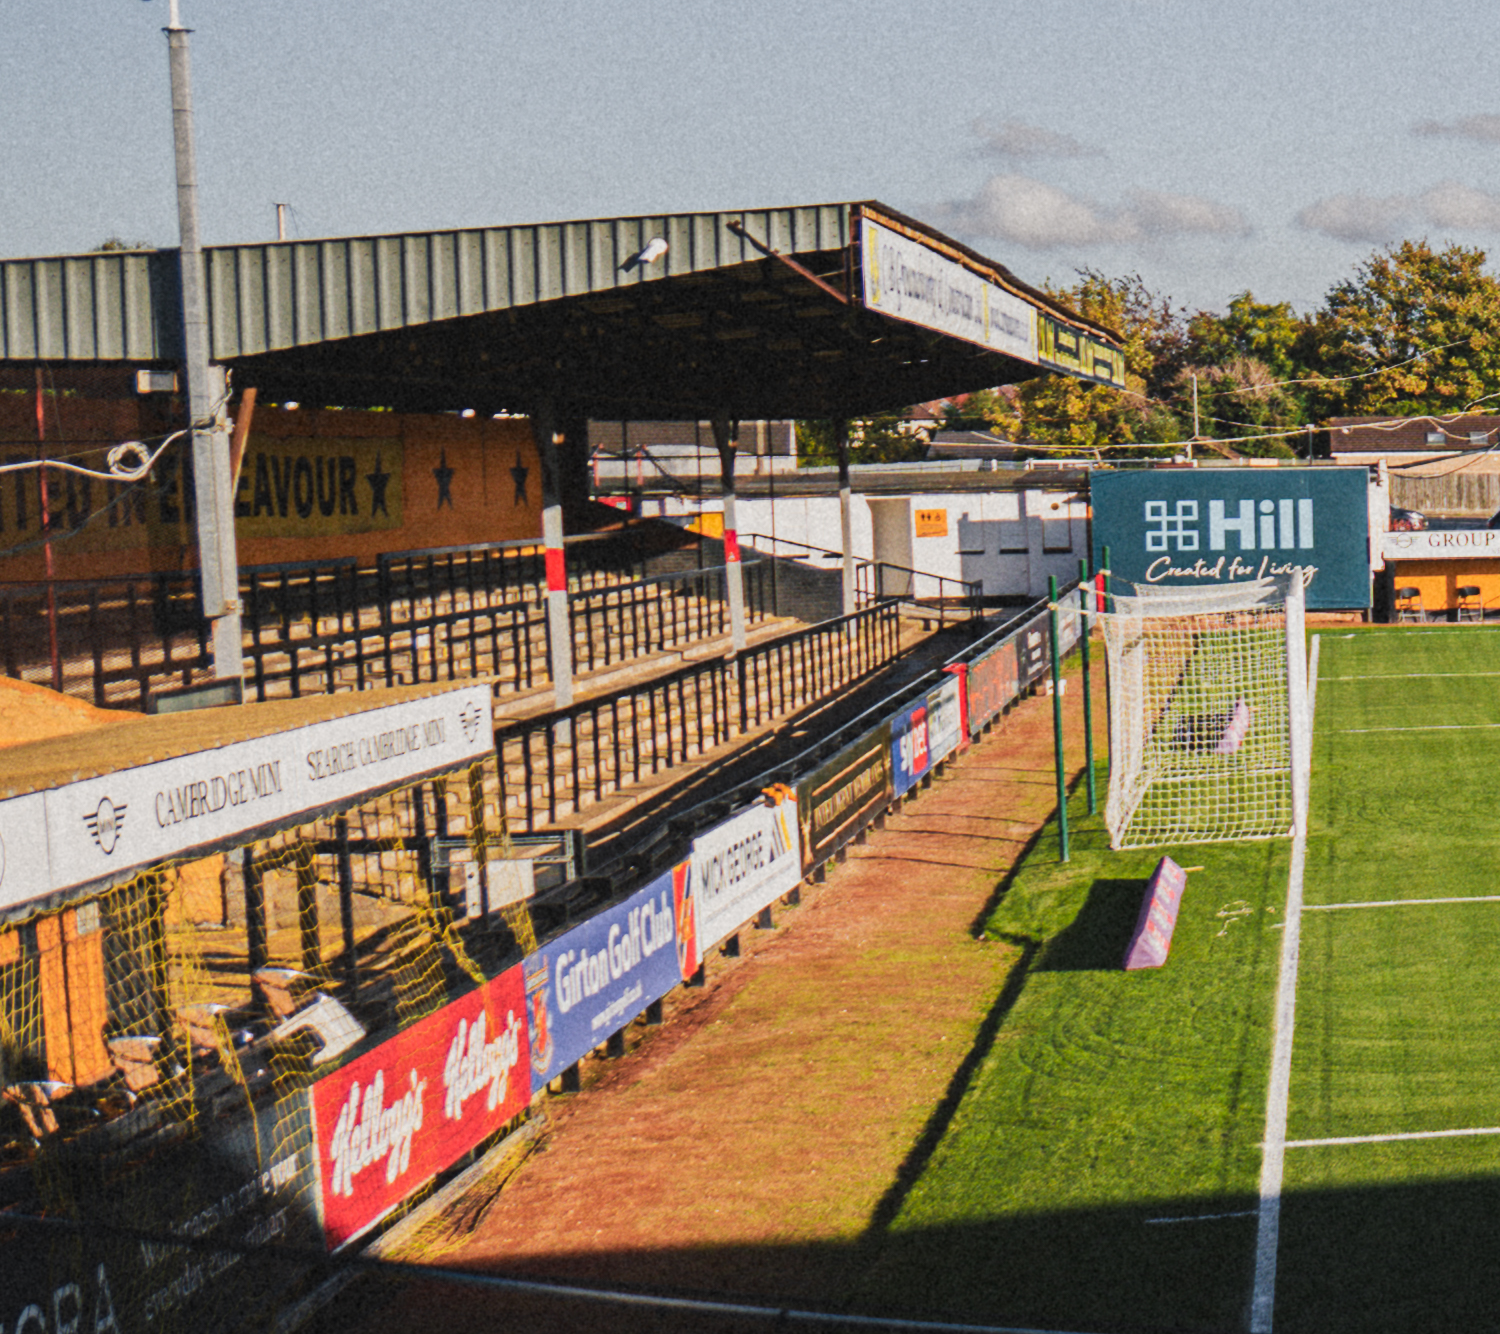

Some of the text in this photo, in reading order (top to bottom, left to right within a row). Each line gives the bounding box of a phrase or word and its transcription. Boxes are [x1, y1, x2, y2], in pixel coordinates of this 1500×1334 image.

[1209, 499, 1314, 550] Hill
[1428, 533, 1495, 547] GROUP
[1145, 555, 1221, 583] Created
[1227, 556, 1255, 581] for
[154, 769, 247, 828] CAMBRIDGE
[249, 759, 283, 805] MINI
[359, 724, 420, 767] CAMBRIDGE
[701, 849, 727, 903] MICK
[727, 829, 765, 887] GEORGE
[555, 948, 610, 1014] Girton
[608, 907, 642, 980] Golf
[640, 890, 674, 957] Club
[444, 1009, 522, 1121] Kellogg's
[330, 1067, 427, 1198] Kellogg's
[270, 1152, 298, 1197] your
